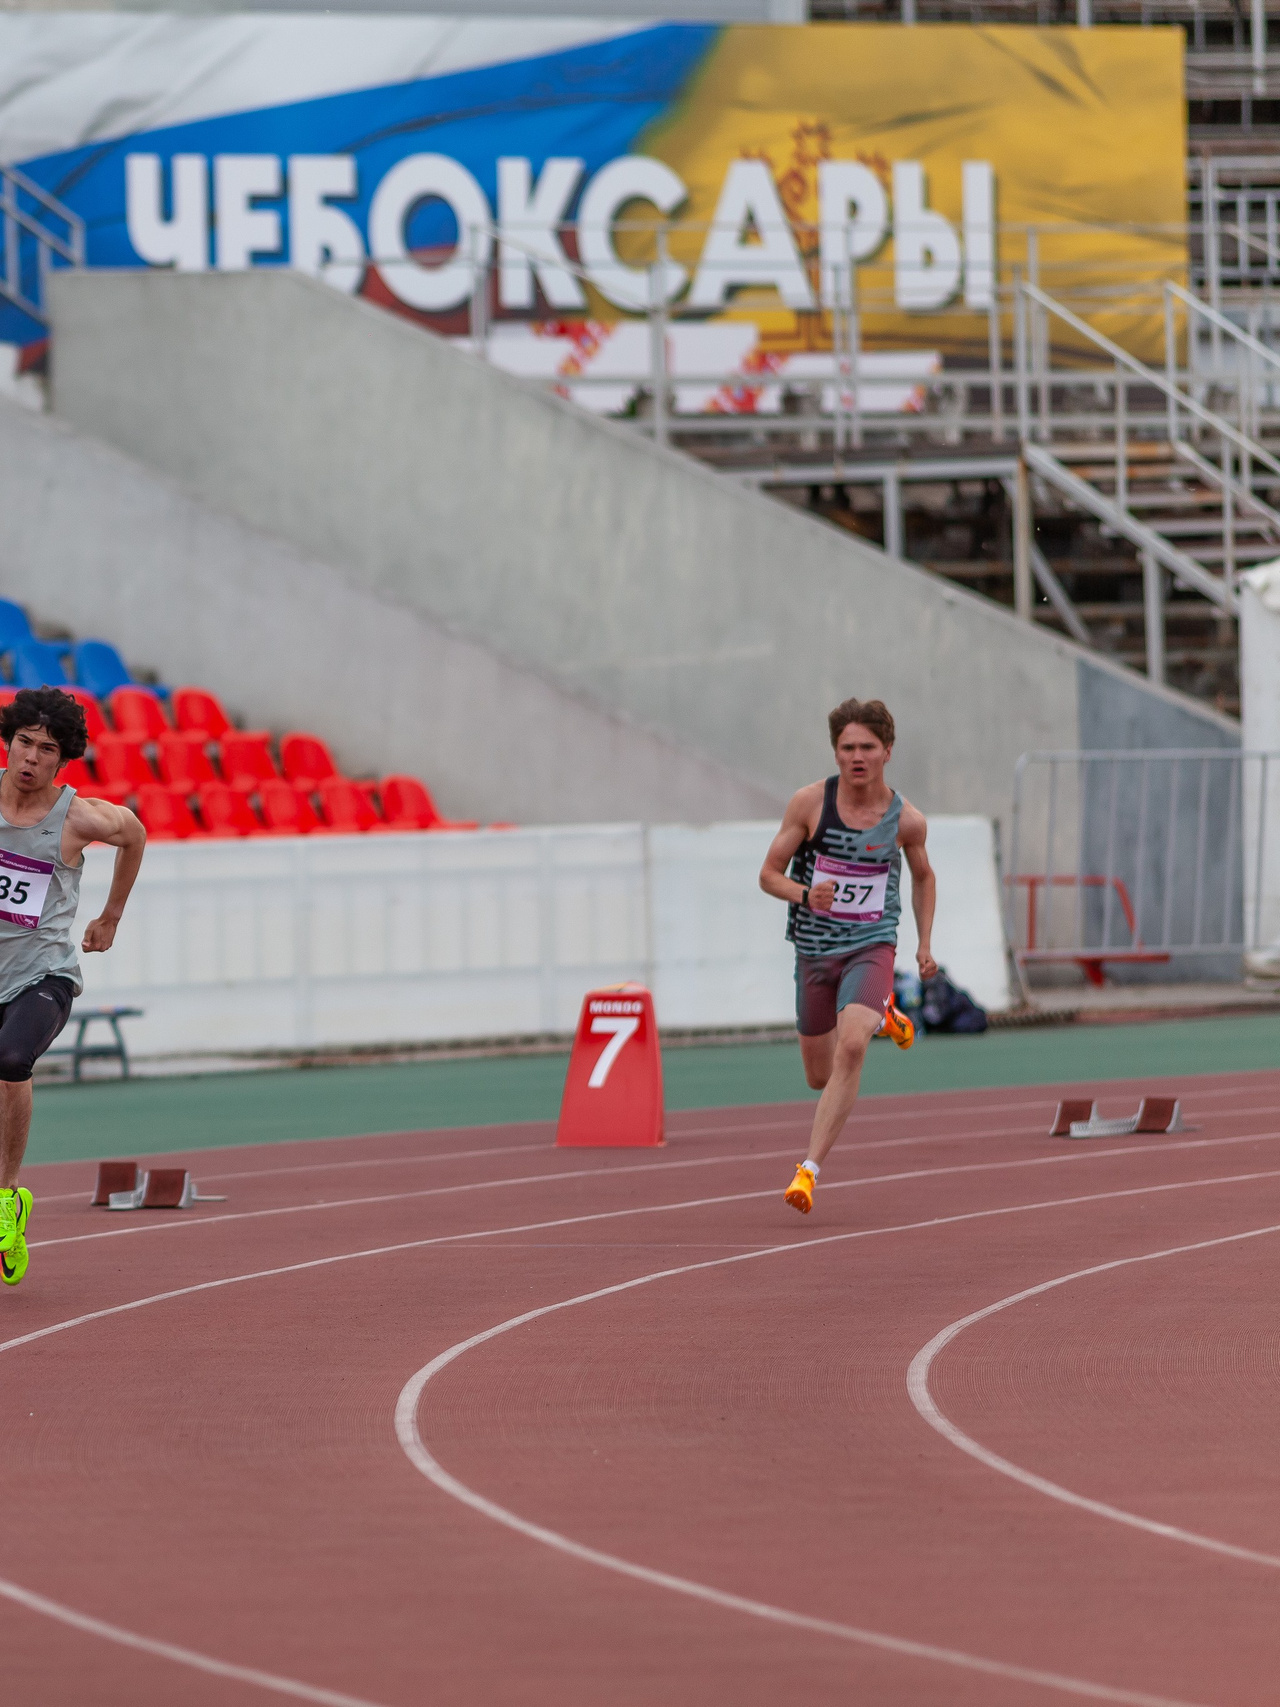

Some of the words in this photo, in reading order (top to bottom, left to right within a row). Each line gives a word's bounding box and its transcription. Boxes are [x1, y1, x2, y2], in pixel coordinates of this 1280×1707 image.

[125, 152, 995, 312] ЧЕБОКСАРЫ
[589, 1000, 642, 1014] MONDO
[587, 1016, 640, 1089] 7
